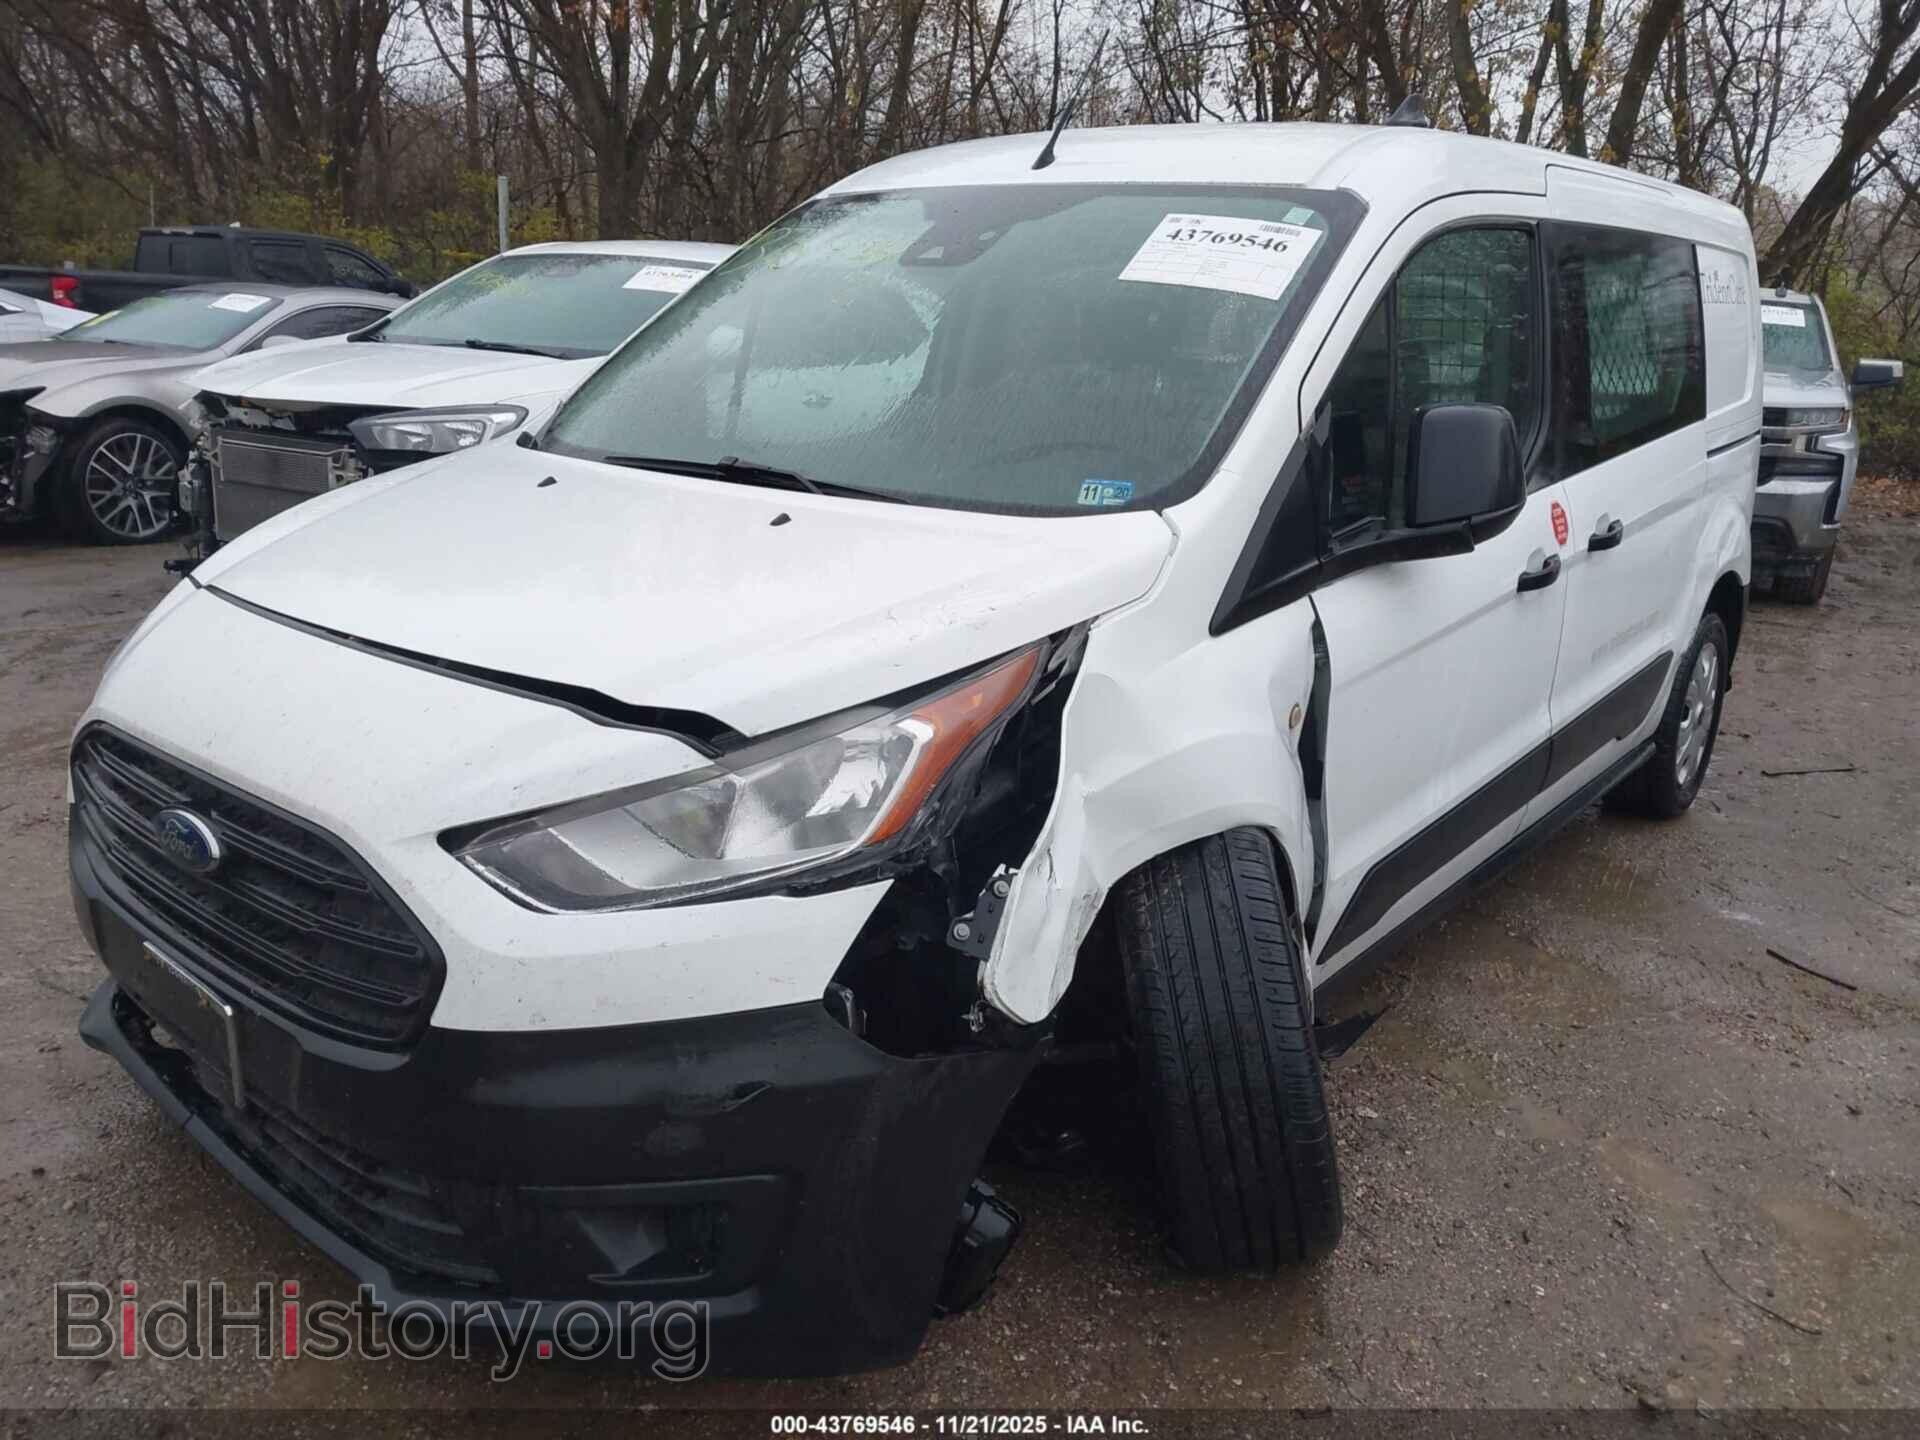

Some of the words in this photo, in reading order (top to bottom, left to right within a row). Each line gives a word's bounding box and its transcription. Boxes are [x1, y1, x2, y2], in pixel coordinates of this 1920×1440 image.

[1166, 228, 1289, 253] 43769546
[1083, 485, 1099, 501] 11
[160, 818, 200, 861] Ford
